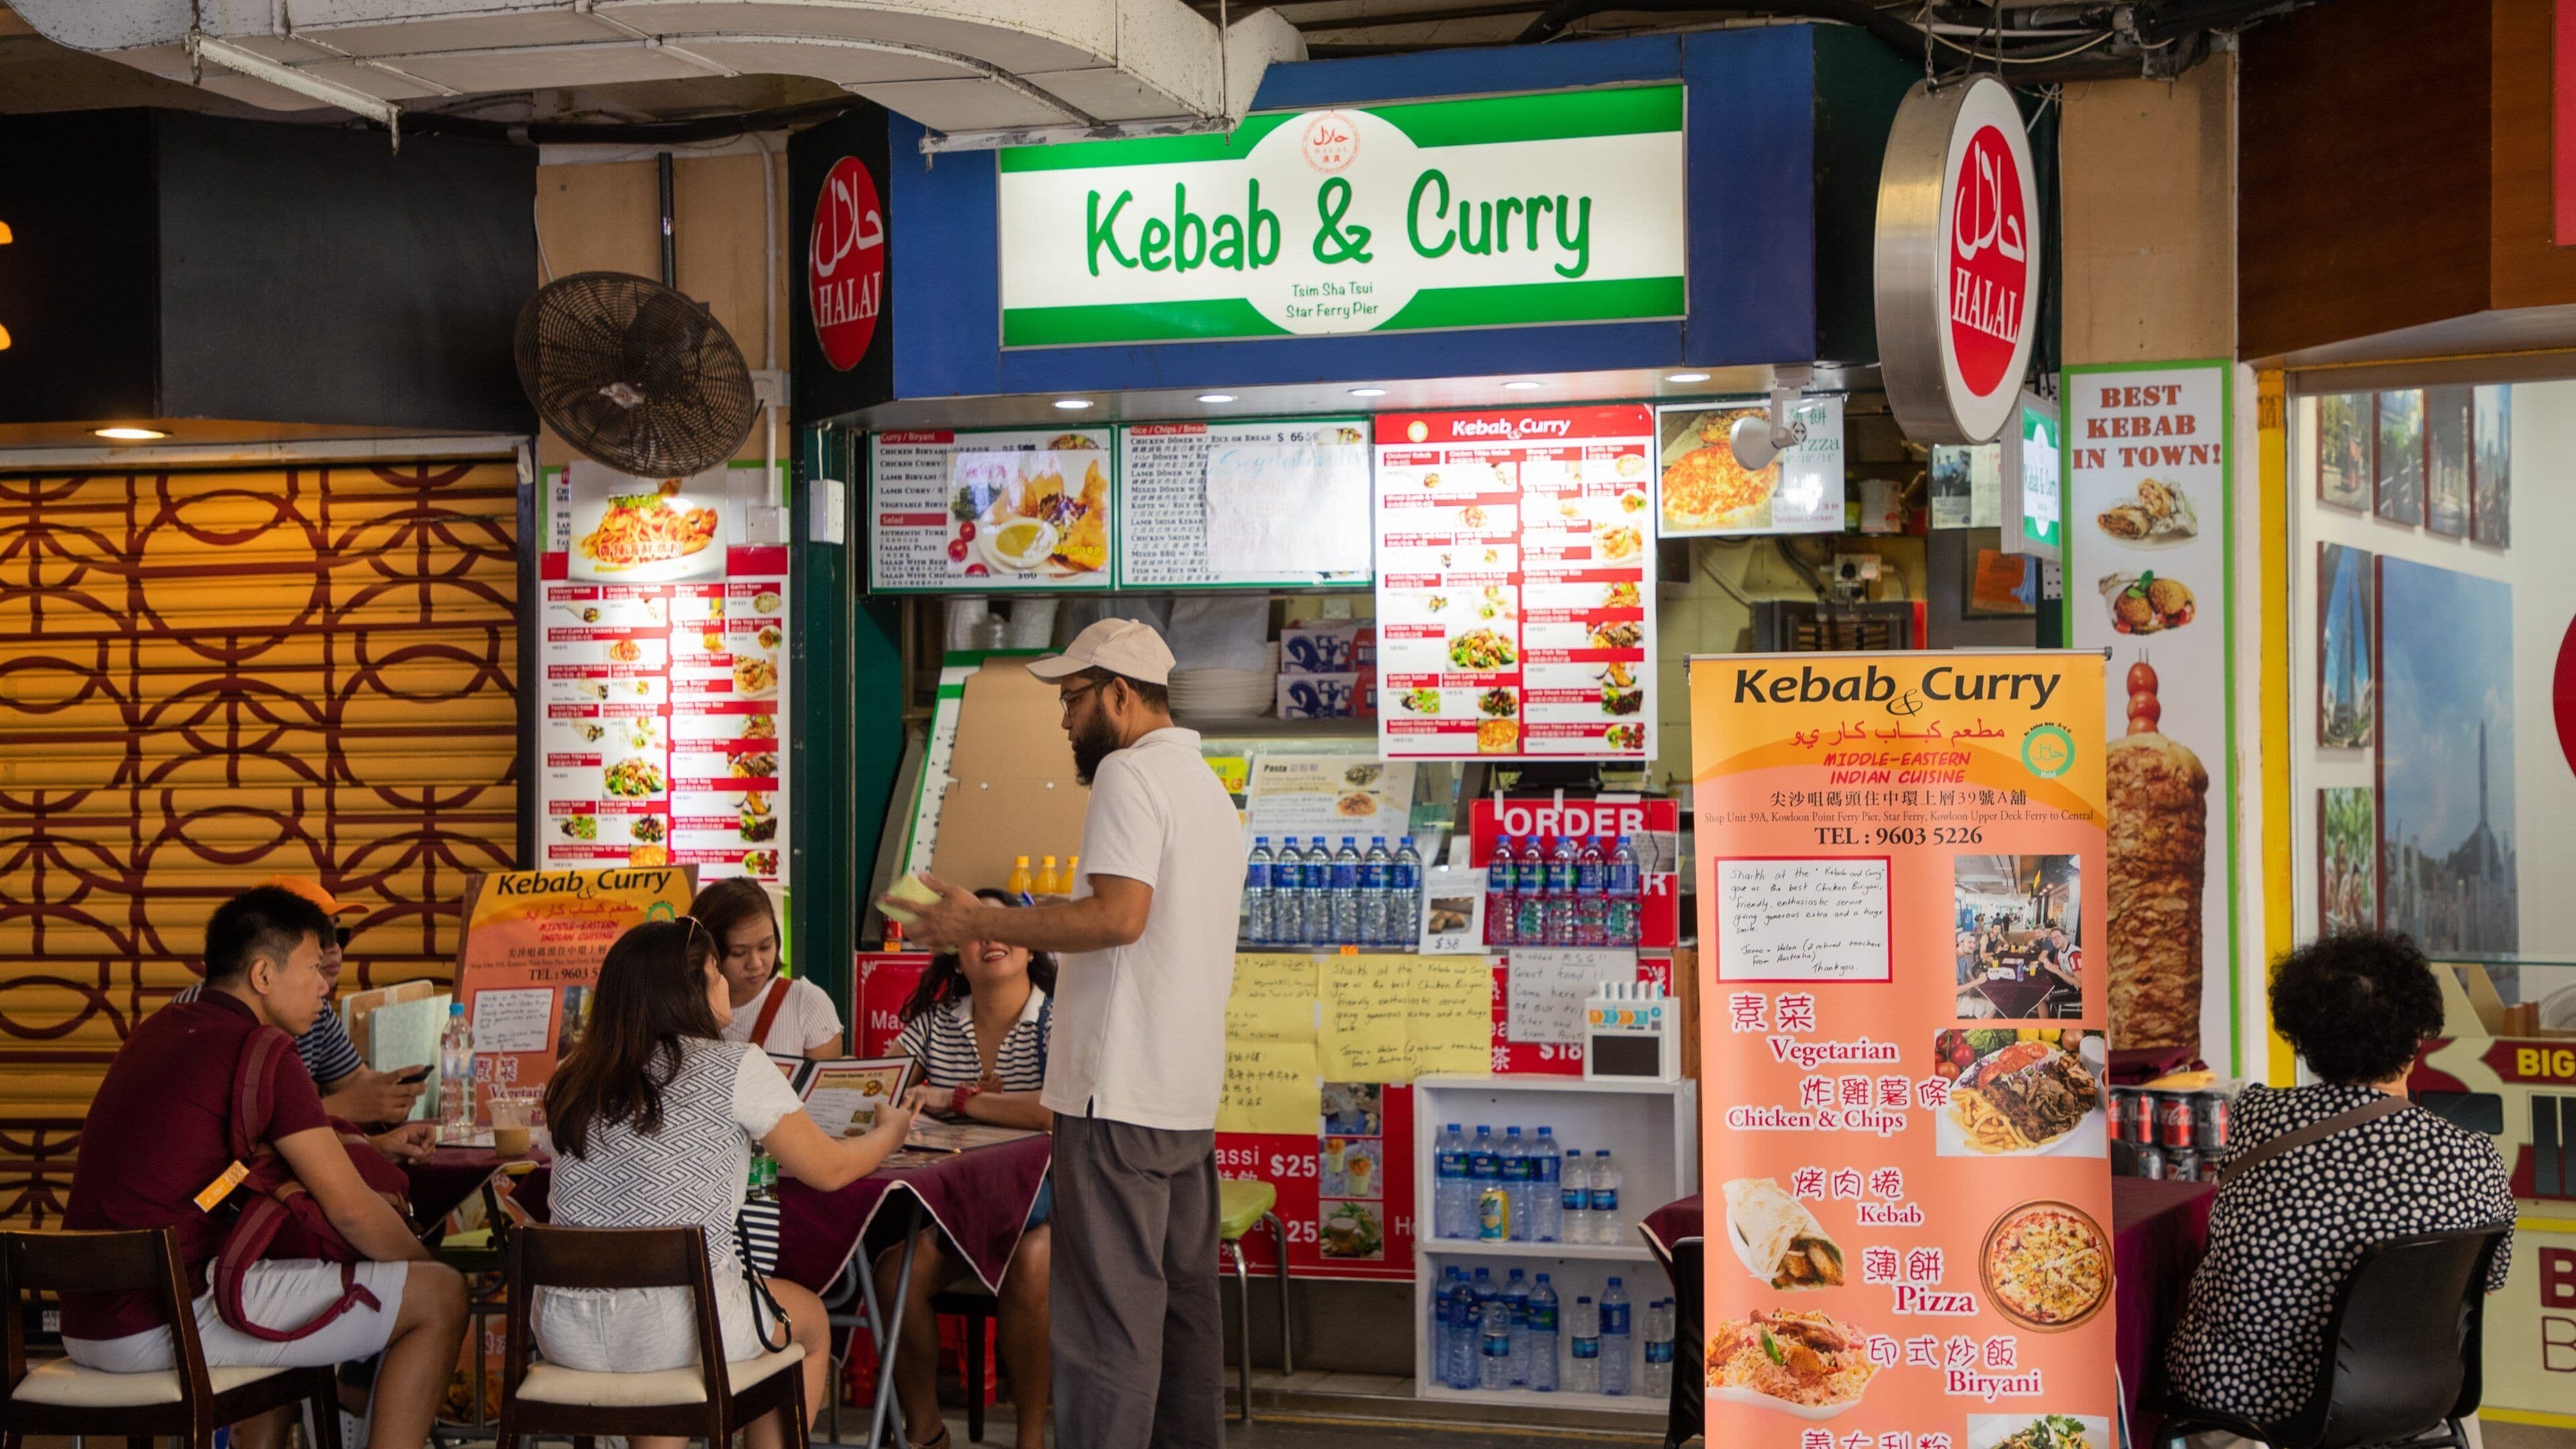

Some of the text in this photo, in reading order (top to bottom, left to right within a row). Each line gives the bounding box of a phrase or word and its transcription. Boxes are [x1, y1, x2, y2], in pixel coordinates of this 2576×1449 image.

[1955, 141, 2024, 263] حلال
[816, 171, 883, 278] حلال
[1086, 168, 1592, 278] Kebab & Curry
[1293, 281, 1373, 297] Tsim Sha Tsui
[1287, 301, 1379, 319] Star Ferry Pier
[1952, 268, 2018, 345] HALAL
[2100, 384, 2182, 409] BEST
[881, 433, 902, 442] Curry
[1452, 419, 1511, 436] Kebab
[1519, 418, 1571, 436] Curry
[2086, 415, 2196, 439] KEBAB
[2073, 443, 2221, 470] IN TOWN!
[882, 516, 904, 524] Salad
[1734, 666, 2061, 716] Kebab & Curry
[1951, 718, 2005, 747] مطعم
[1823, 752, 1971, 766] MIDDLE-EASTERN
[1830, 769, 1966, 785] INDIAN CUISINE
[1503, 808, 1644, 837] ORDER
[1704, 810, 2094, 824] Shop Unit 39A, Kowloon Point Ferry Pier, Star Ferry, Kowloon Upper Deck Ferry to Central
[1815, 827, 1859, 845] TEL
[1876, 826, 1926, 845] 9603
[1933, 826, 1982, 845] 5226
[497, 869, 672, 900] Kebab & Curry
[1774, 869, 1785, 879] at
[1794, 867, 1809, 877] the
[1770, 883, 1781, 892] the
[1788, 882, 1808, 892] best
[1815, 882, 1847, 891] Chicken
[1777, 897, 1827, 907] enthusiastic
[539, 920, 619, 931] MIDDLE-EASTERN
[1733, 914, 1757, 927] giving
[1764, 912, 1799, 926] generous
[1834, 908, 1849, 917] and
[1864, 907, 1883, 918] huge
[541, 932, 574, 943] INDIAN
[1777, 943, 1796, 952] Helen
[1848, 940, 1881, 948] teachers
[1752, 955, 1769, 966] from
[529, 969, 588, 981] TEL 9603
[1732, 994, 1812, 1030] 素菜
[1493, 1046, 1511, 1071] 茶
[1770, 1038, 1897, 1067] Vegetarian
[2517, 1048, 2576, 1077] BIG
[1803, 1077, 1949, 1107] 炸雞薯條
[1729, 1110, 1904, 1134] Chicken & Chips
[1215, 1145, 1259, 1166] assi
[1270, 1154, 1317, 1177] $25
[1793, 1169, 1902, 1198] 烤肉捲
[1860, 1206, 1922, 1224] Kebab
[1287, 1220, 1318, 1243] 25
[1866, 1250, 1941, 1282] 薄餅
[1896, 1285, 1975, 1313] Pizza
[1869, 1339, 2015, 1367] 印式炒飯
[1948, 1371, 2041, 1401] Biryani
